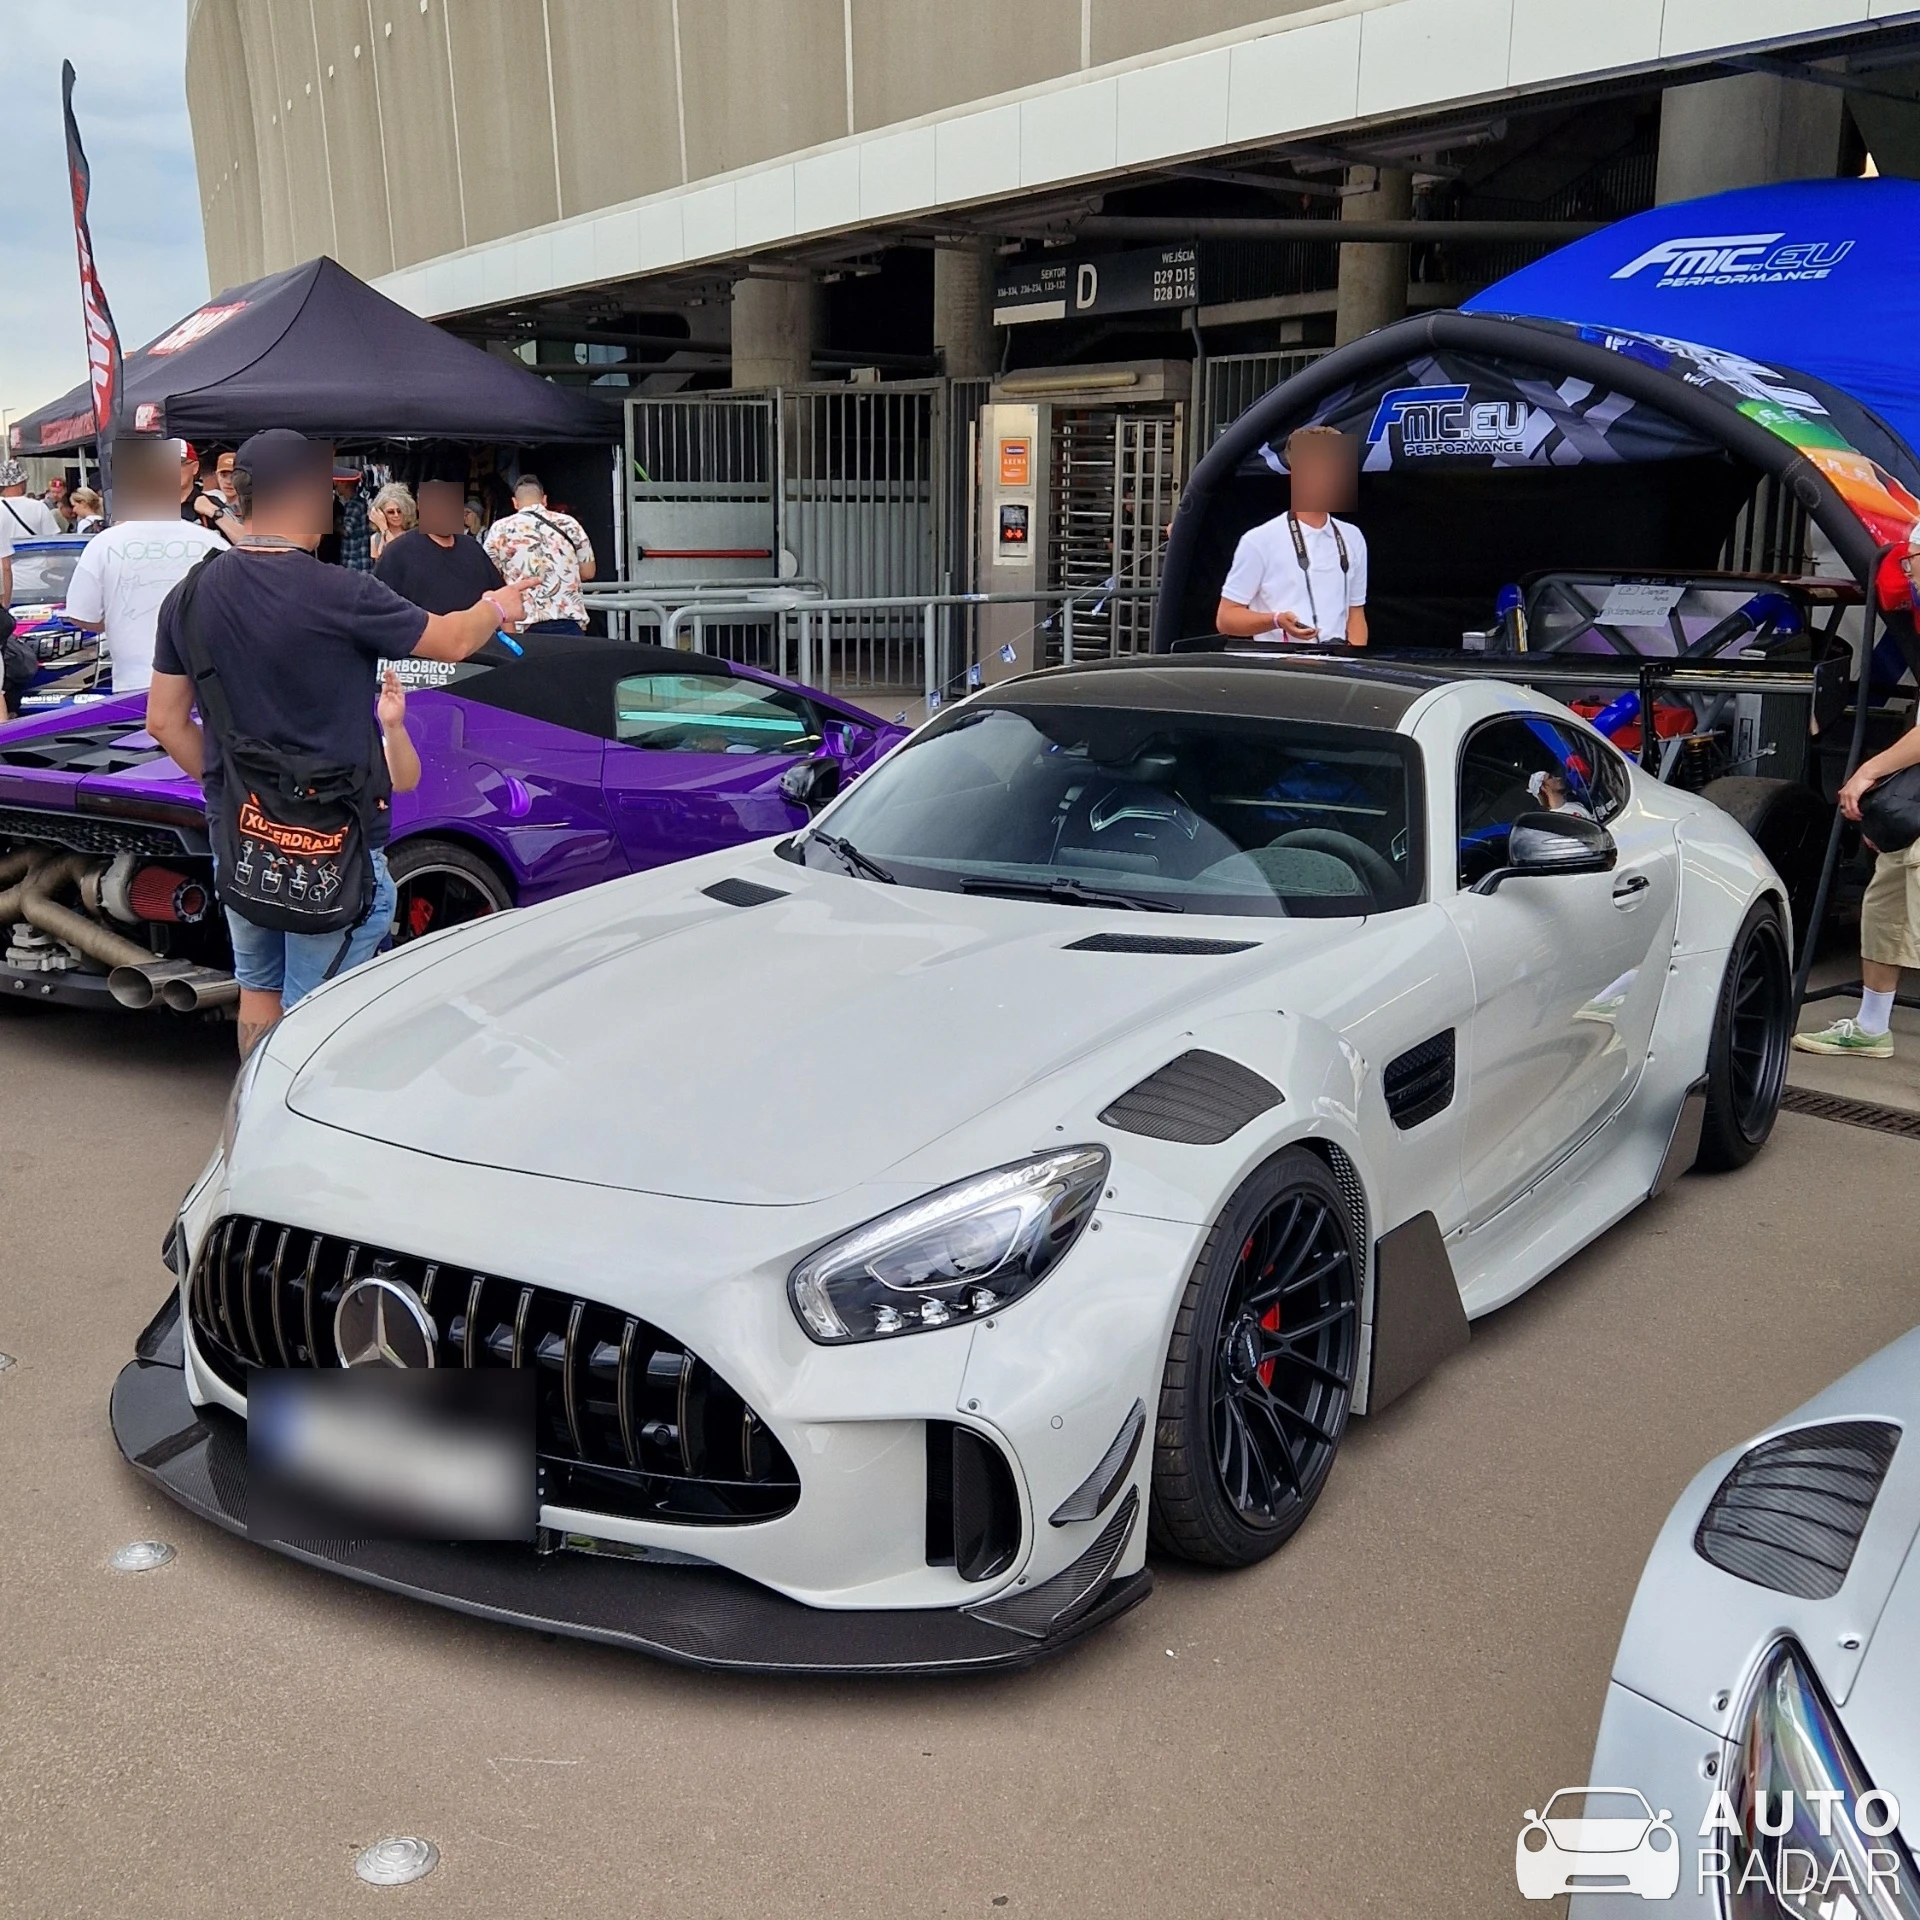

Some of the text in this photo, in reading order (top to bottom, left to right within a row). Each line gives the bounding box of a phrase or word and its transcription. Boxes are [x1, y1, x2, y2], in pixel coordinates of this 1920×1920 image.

[1161, 248, 1195, 264] WEJŚCIA
[1040, 267, 1066, 280] SEKTOR
[1154, 267, 1196, 285] D29 D15
[1656, 268, 1832, 289] PERFORMANCE
[1076, 263, 1098, 310] D
[1153, 284, 1196, 302] D28 D14
[1404, 440, 1525, 457] PERFORMANCE
[107, 540, 209, 564] NOBOD
[377, 658, 457, 675] TURBOBROS
[246, 812, 342, 850] XUERDRAUF
